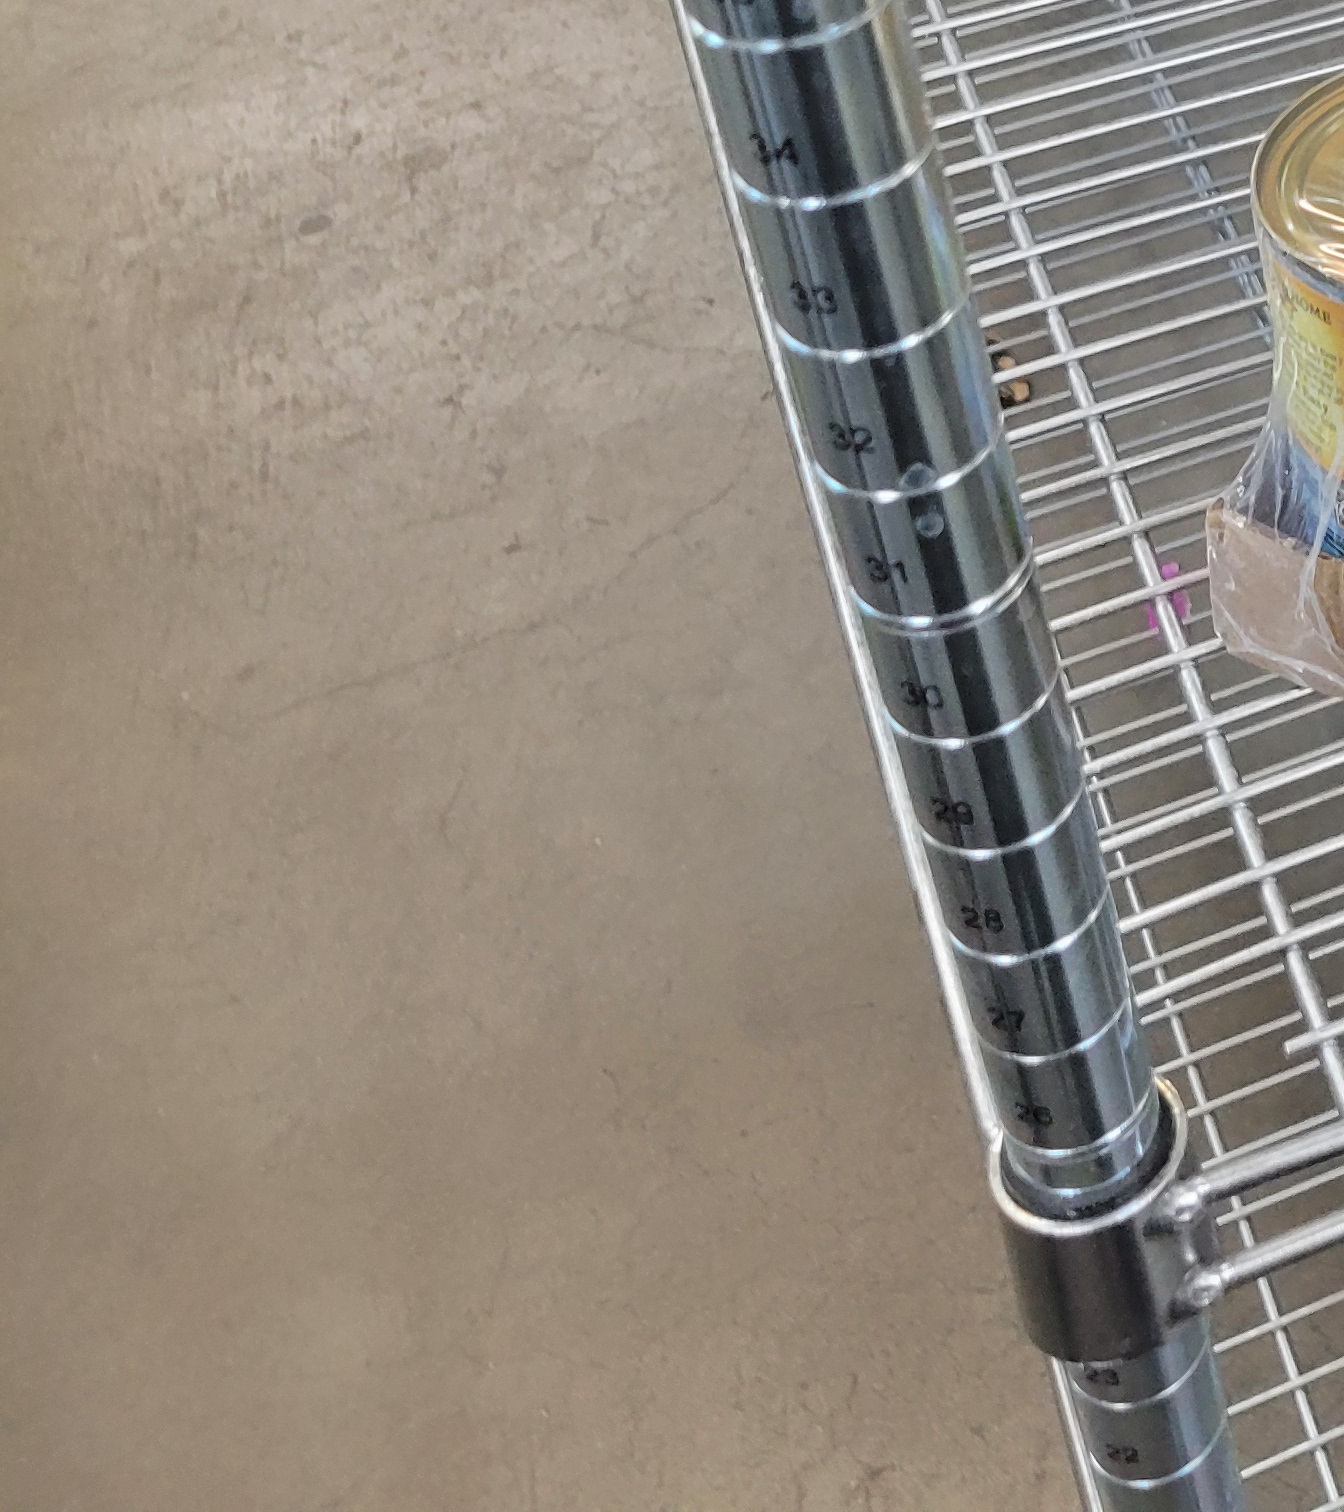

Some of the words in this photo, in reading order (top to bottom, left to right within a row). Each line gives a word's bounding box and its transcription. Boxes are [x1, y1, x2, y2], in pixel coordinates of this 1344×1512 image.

[829, 422, 876, 455] 32
[865, 555, 908, 584] 31
[900, 679, 945, 710] 30
[961, 904, 1005, 934] 28
[986, 1005, 1026, 1033] 27
[1014, 1101, 1054, 1126] 26
